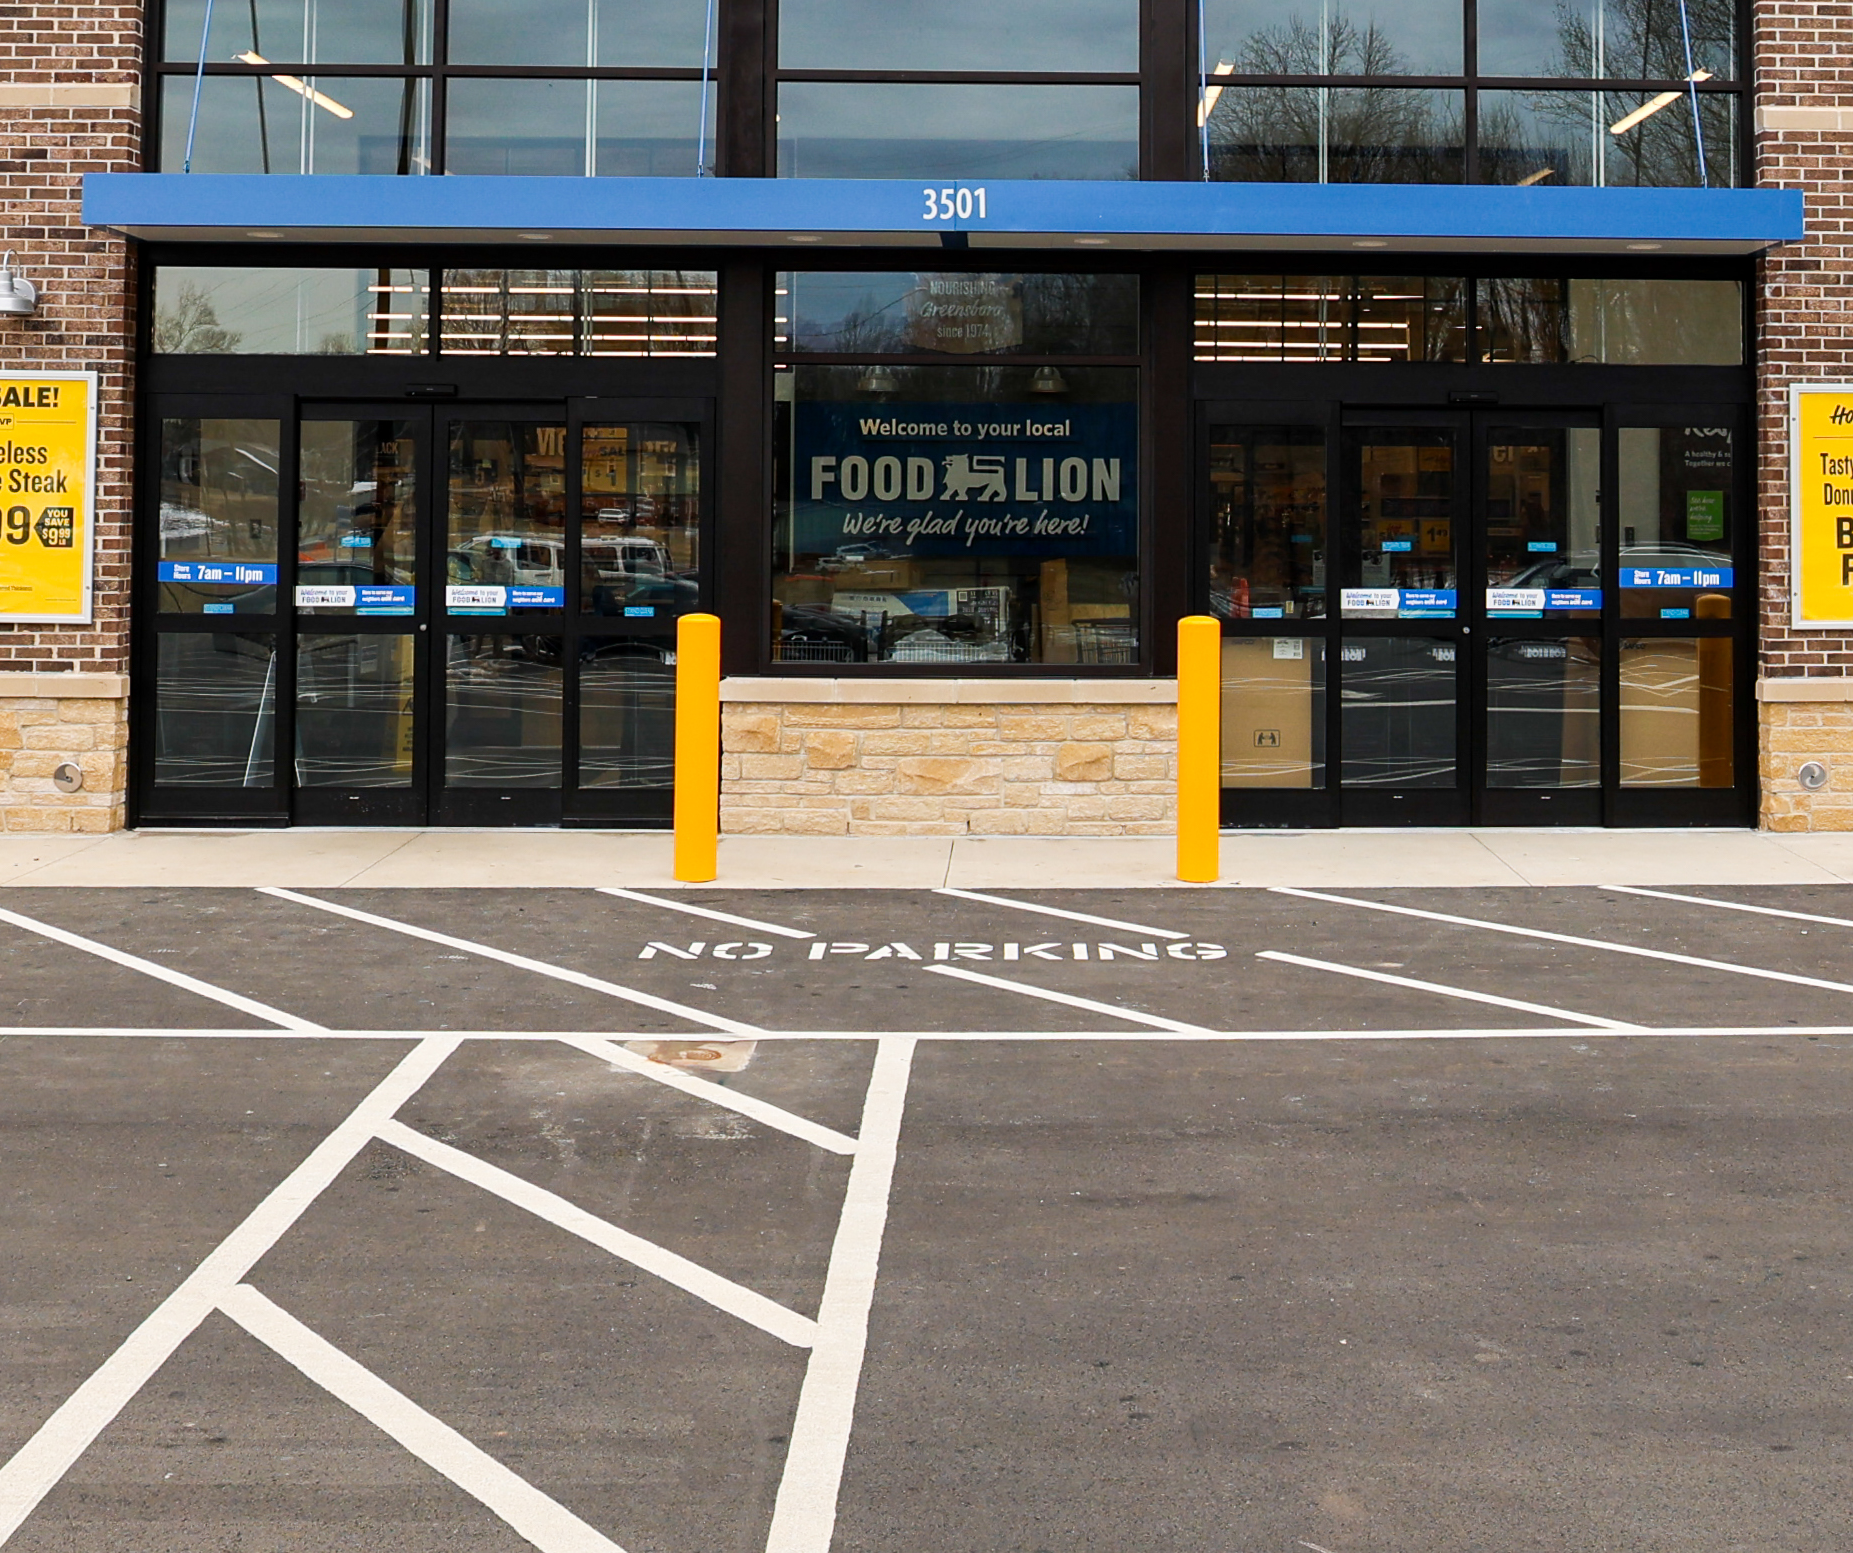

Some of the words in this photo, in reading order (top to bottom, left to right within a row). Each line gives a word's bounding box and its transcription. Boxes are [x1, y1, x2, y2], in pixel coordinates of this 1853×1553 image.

[922, 187, 987, 220] 3501
[930, 280, 996, 296] NOURISHING
[920, 300, 1003, 317] Greensboro
[937, 325, 963, 338] since
[966, 324, 989, 338] 1974
[859, 418, 947, 436] Welcome
[953, 420, 972, 436] to
[978, 422, 1021, 439] your
[1026, 420, 1070, 436] local
[1691, 451, 1716, 459] healthy
[8, 469, 67, 493] Steak
[811, 455, 934, 501] FOOD
[1015, 457, 1120, 502] LION
[44, 518, 70, 526] SAVE
[46, 509, 68, 518] YOU
[843, 511, 902, 535] We're
[907, 510, 957, 545] glad
[964, 512, 1030, 547] you're
[1034, 509, 1089, 535] here!
[173, 564, 190, 572] Store
[173, 572, 191, 580] Hours
[197, 565, 222, 581] 7am
[235, 565, 263, 583] 11pm
[1634, 570, 1649, 578] Store
[1657, 571, 1681, 585] 7am
[1694, 570, 1720, 587] 11pm
[638, 942, 775, 961] NO
[807, 941, 1228, 961] PARKING
